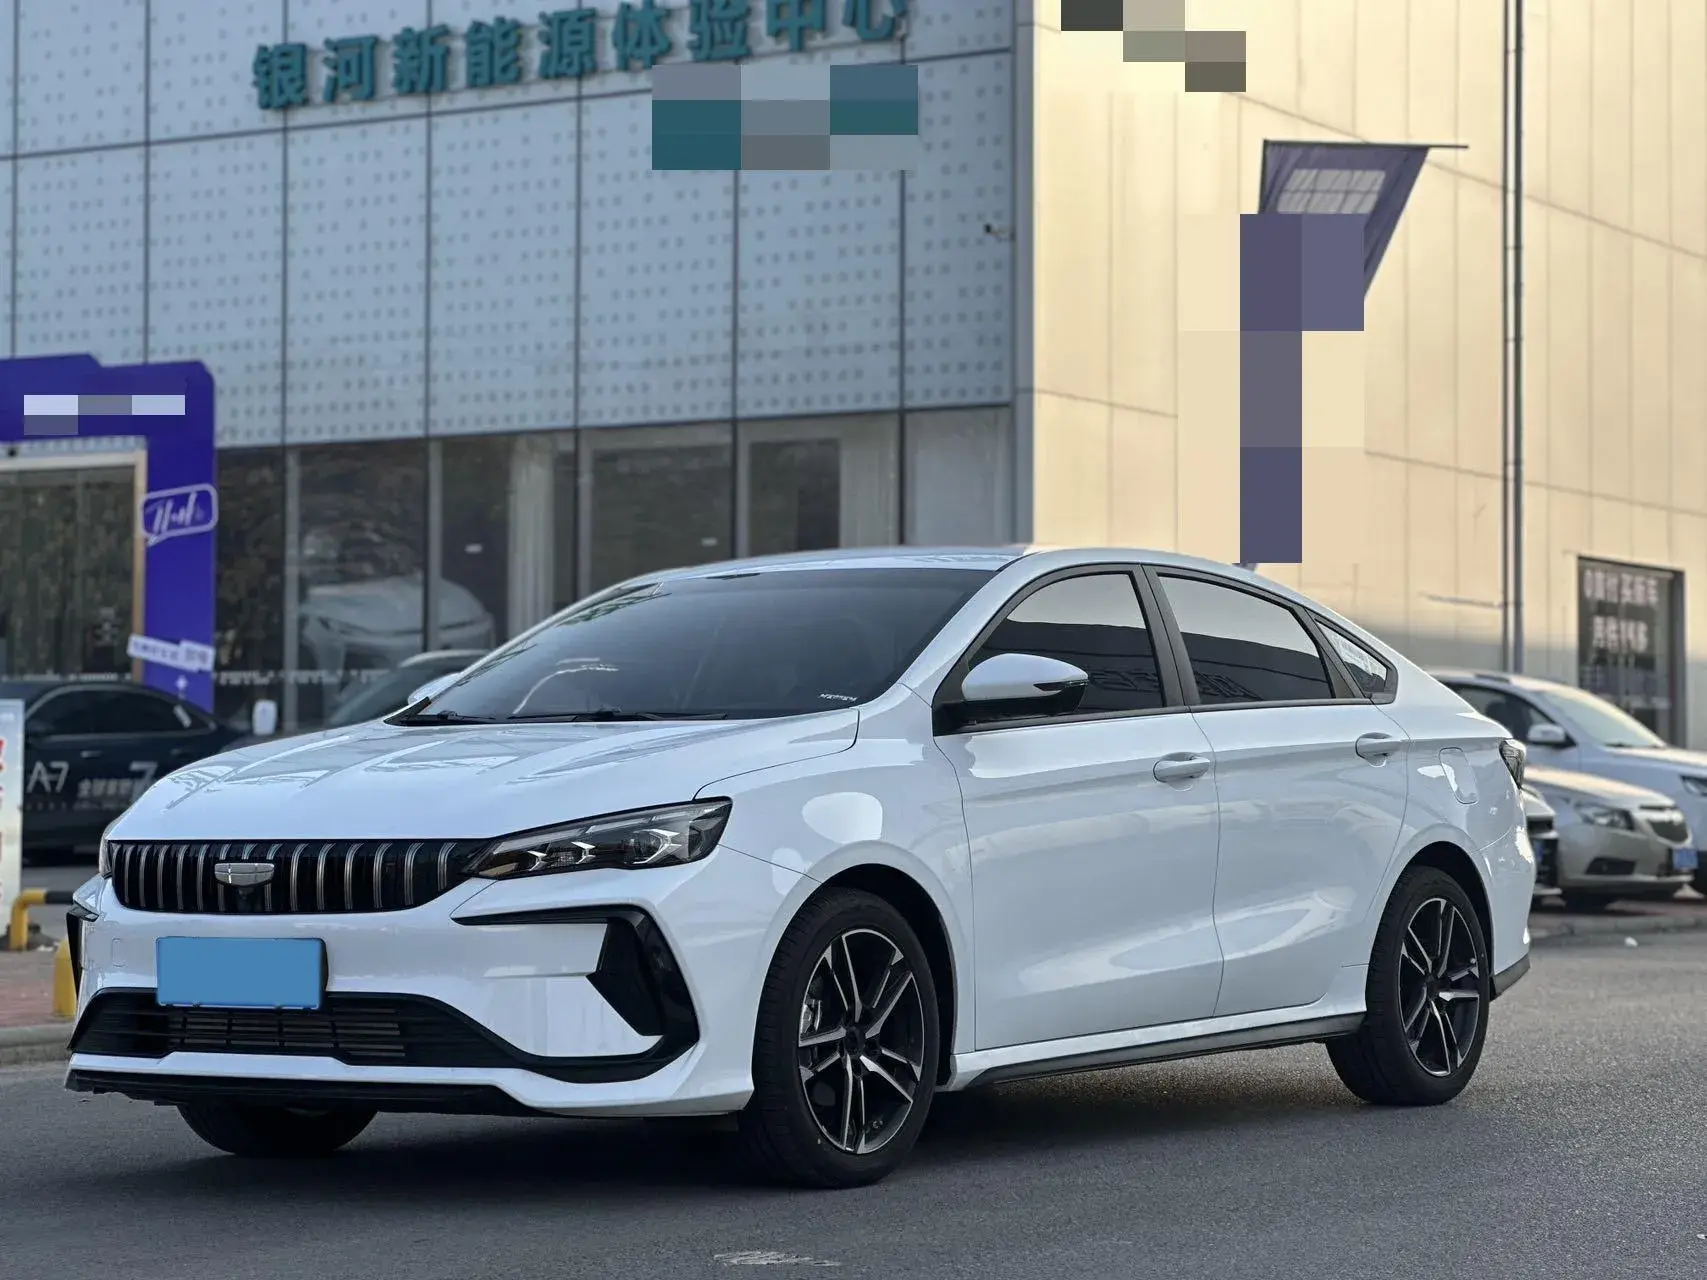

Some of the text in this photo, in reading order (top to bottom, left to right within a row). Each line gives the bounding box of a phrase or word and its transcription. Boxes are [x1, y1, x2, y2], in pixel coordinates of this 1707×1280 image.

[252, 0, 908, 109] 银河新能源体验中心
[26, 760, 70, 793] A7
